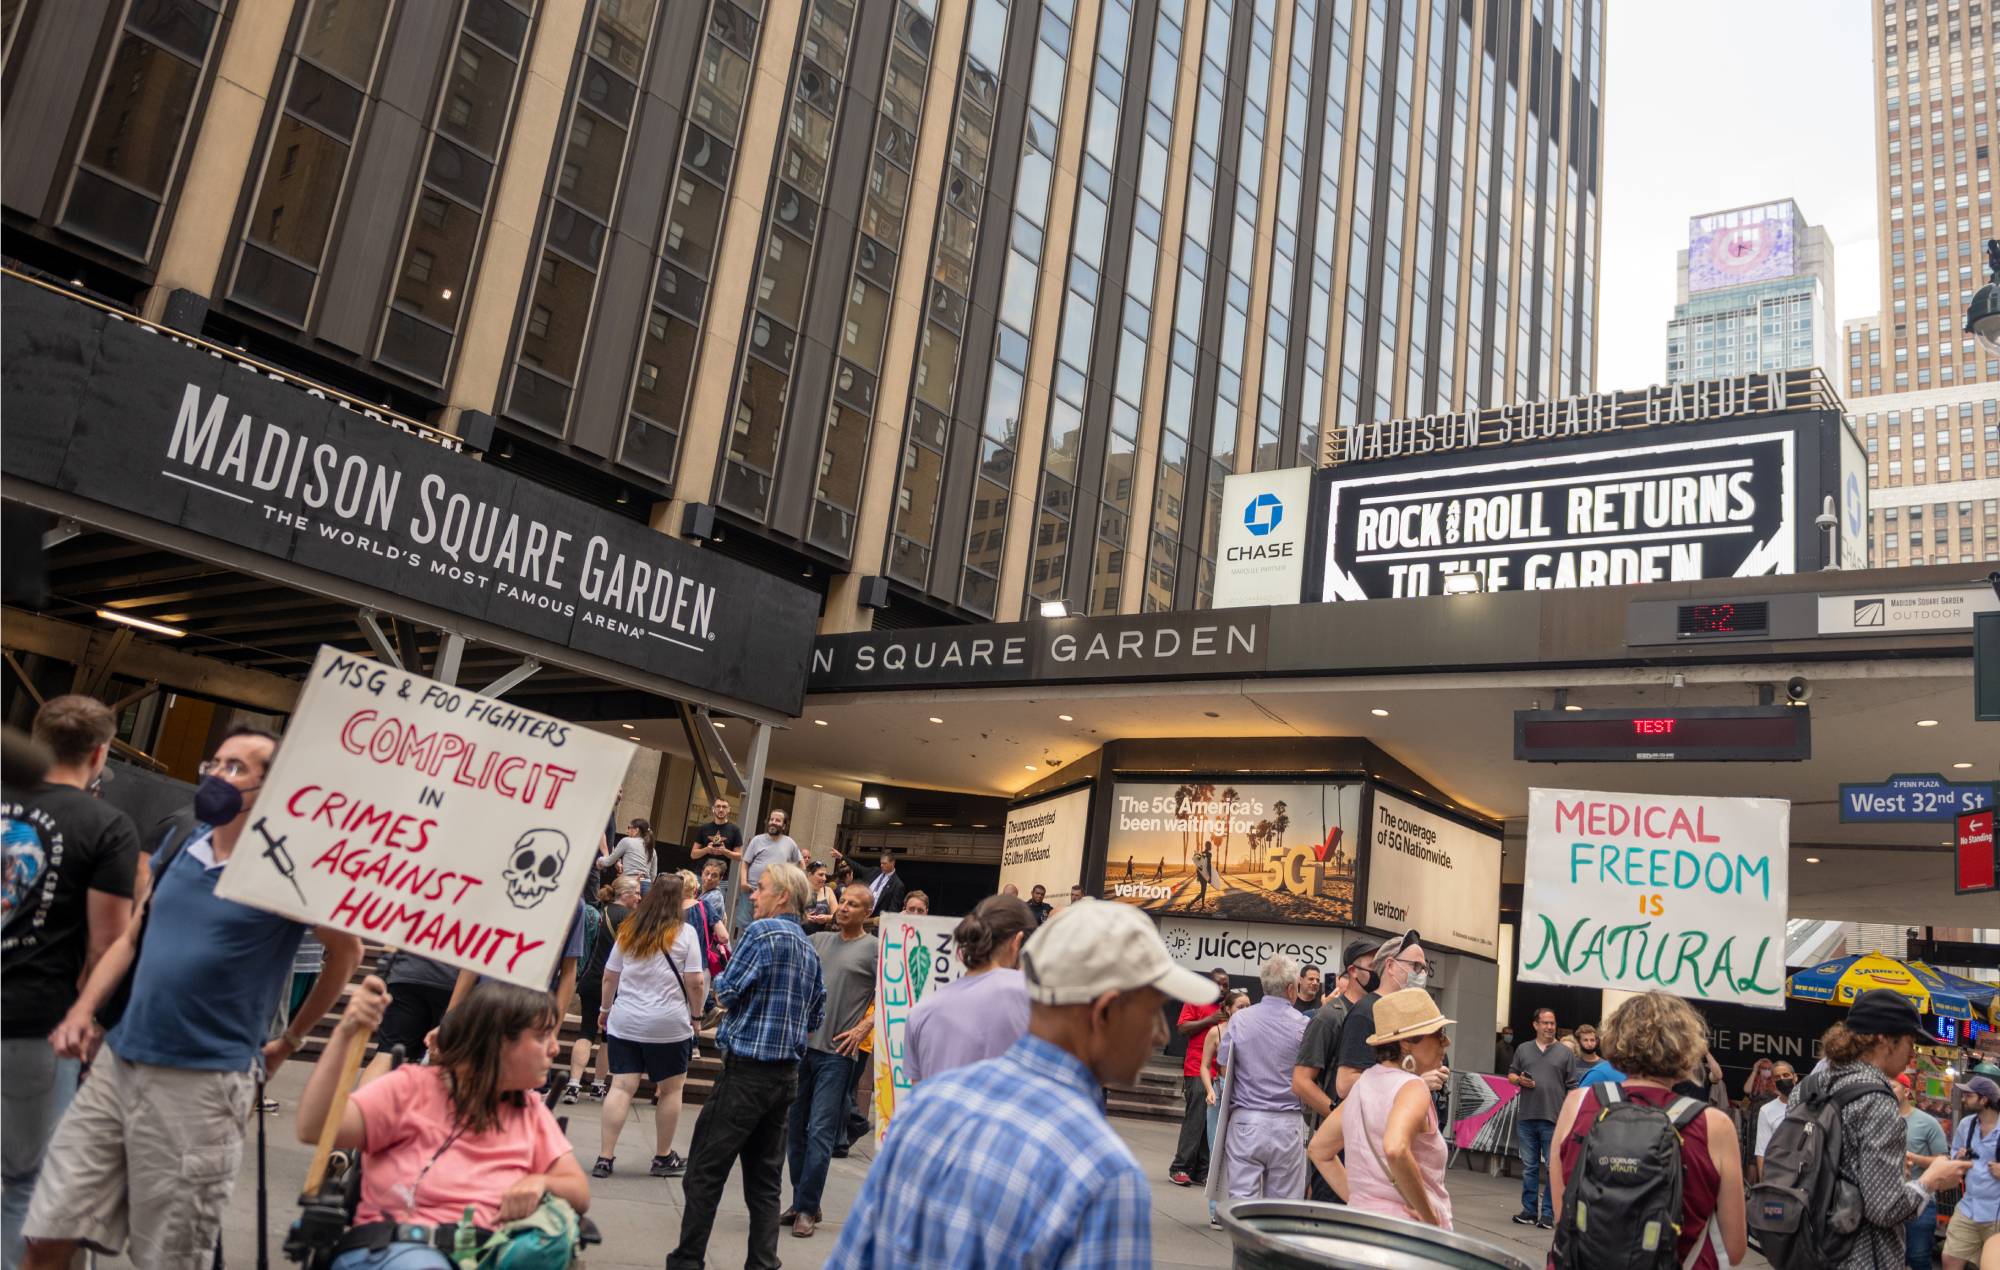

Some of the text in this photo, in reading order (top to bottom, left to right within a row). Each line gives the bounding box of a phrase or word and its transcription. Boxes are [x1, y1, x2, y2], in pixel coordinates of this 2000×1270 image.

[1344, 369, 1787, 461] MADISON SQUARE GARDEN
[167, 383, 402, 531] MADISON
[410, 473, 573, 590] SQUARE
[1356, 502, 1443, 552] ROCK
[1464, 492, 1551, 542] ROLL
[1567, 471, 1756, 537] RETURNS
[263, 504, 307, 531] THE
[319, 523, 421, 567] WORLD'S
[430, 560, 489, 589] MOST
[497, 582, 575, 617] FAMOUS
[1227, 542, 1294, 561] CHASE
[1388, 563, 1430, 599] TO
[1523, 543, 1703, 591] GARDEN
[1893, 609, 1961, 621] OUTDOOR
[855, 637, 1026, 672] SQUARE
[1051, 624, 1256, 662] GARDEN
[322, 655, 571, 748] MSG & FOO FIGHTERS
[1633, 719, 1675, 733] TEST
[340, 709, 578, 810] COMPLICIT
[418, 785, 446, 809] IN
[1851, 791, 1985, 813] West 32nd St
[1899, 780, 1917, 788] PENN
[1918, 780, 1940, 788] PLAZA
[286, 784, 439, 853] CRIMES
[1119, 796, 1264, 816] The 5G America's
[1120, 814, 1257, 836] been waiting for.
[1379, 806, 1437, 845] The coverage
[1555, 800, 1720, 843] MEDICAL
[1377, 830, 1453, 869] of 5G Nationwide.
[1960, 832, 1993, 845] No Standing
[311, 838, 483, 905] AGAINST
[1114, 882, 1172, 900] verizon
[1570, 843, 1769, 902] FREEDOM
[1373, 900, 1405, 922] verizon
[1639, 894, 1664, 916] IS
[330, 887, 545, 974] HUMANITY
[1524, 914, 1781, 997] NATURAL
[883, 933, 913, 1089] ROTECT
[1702, 1030, 1731, 1050] HE
[1739, 1032, 1802, 1057] PENN
